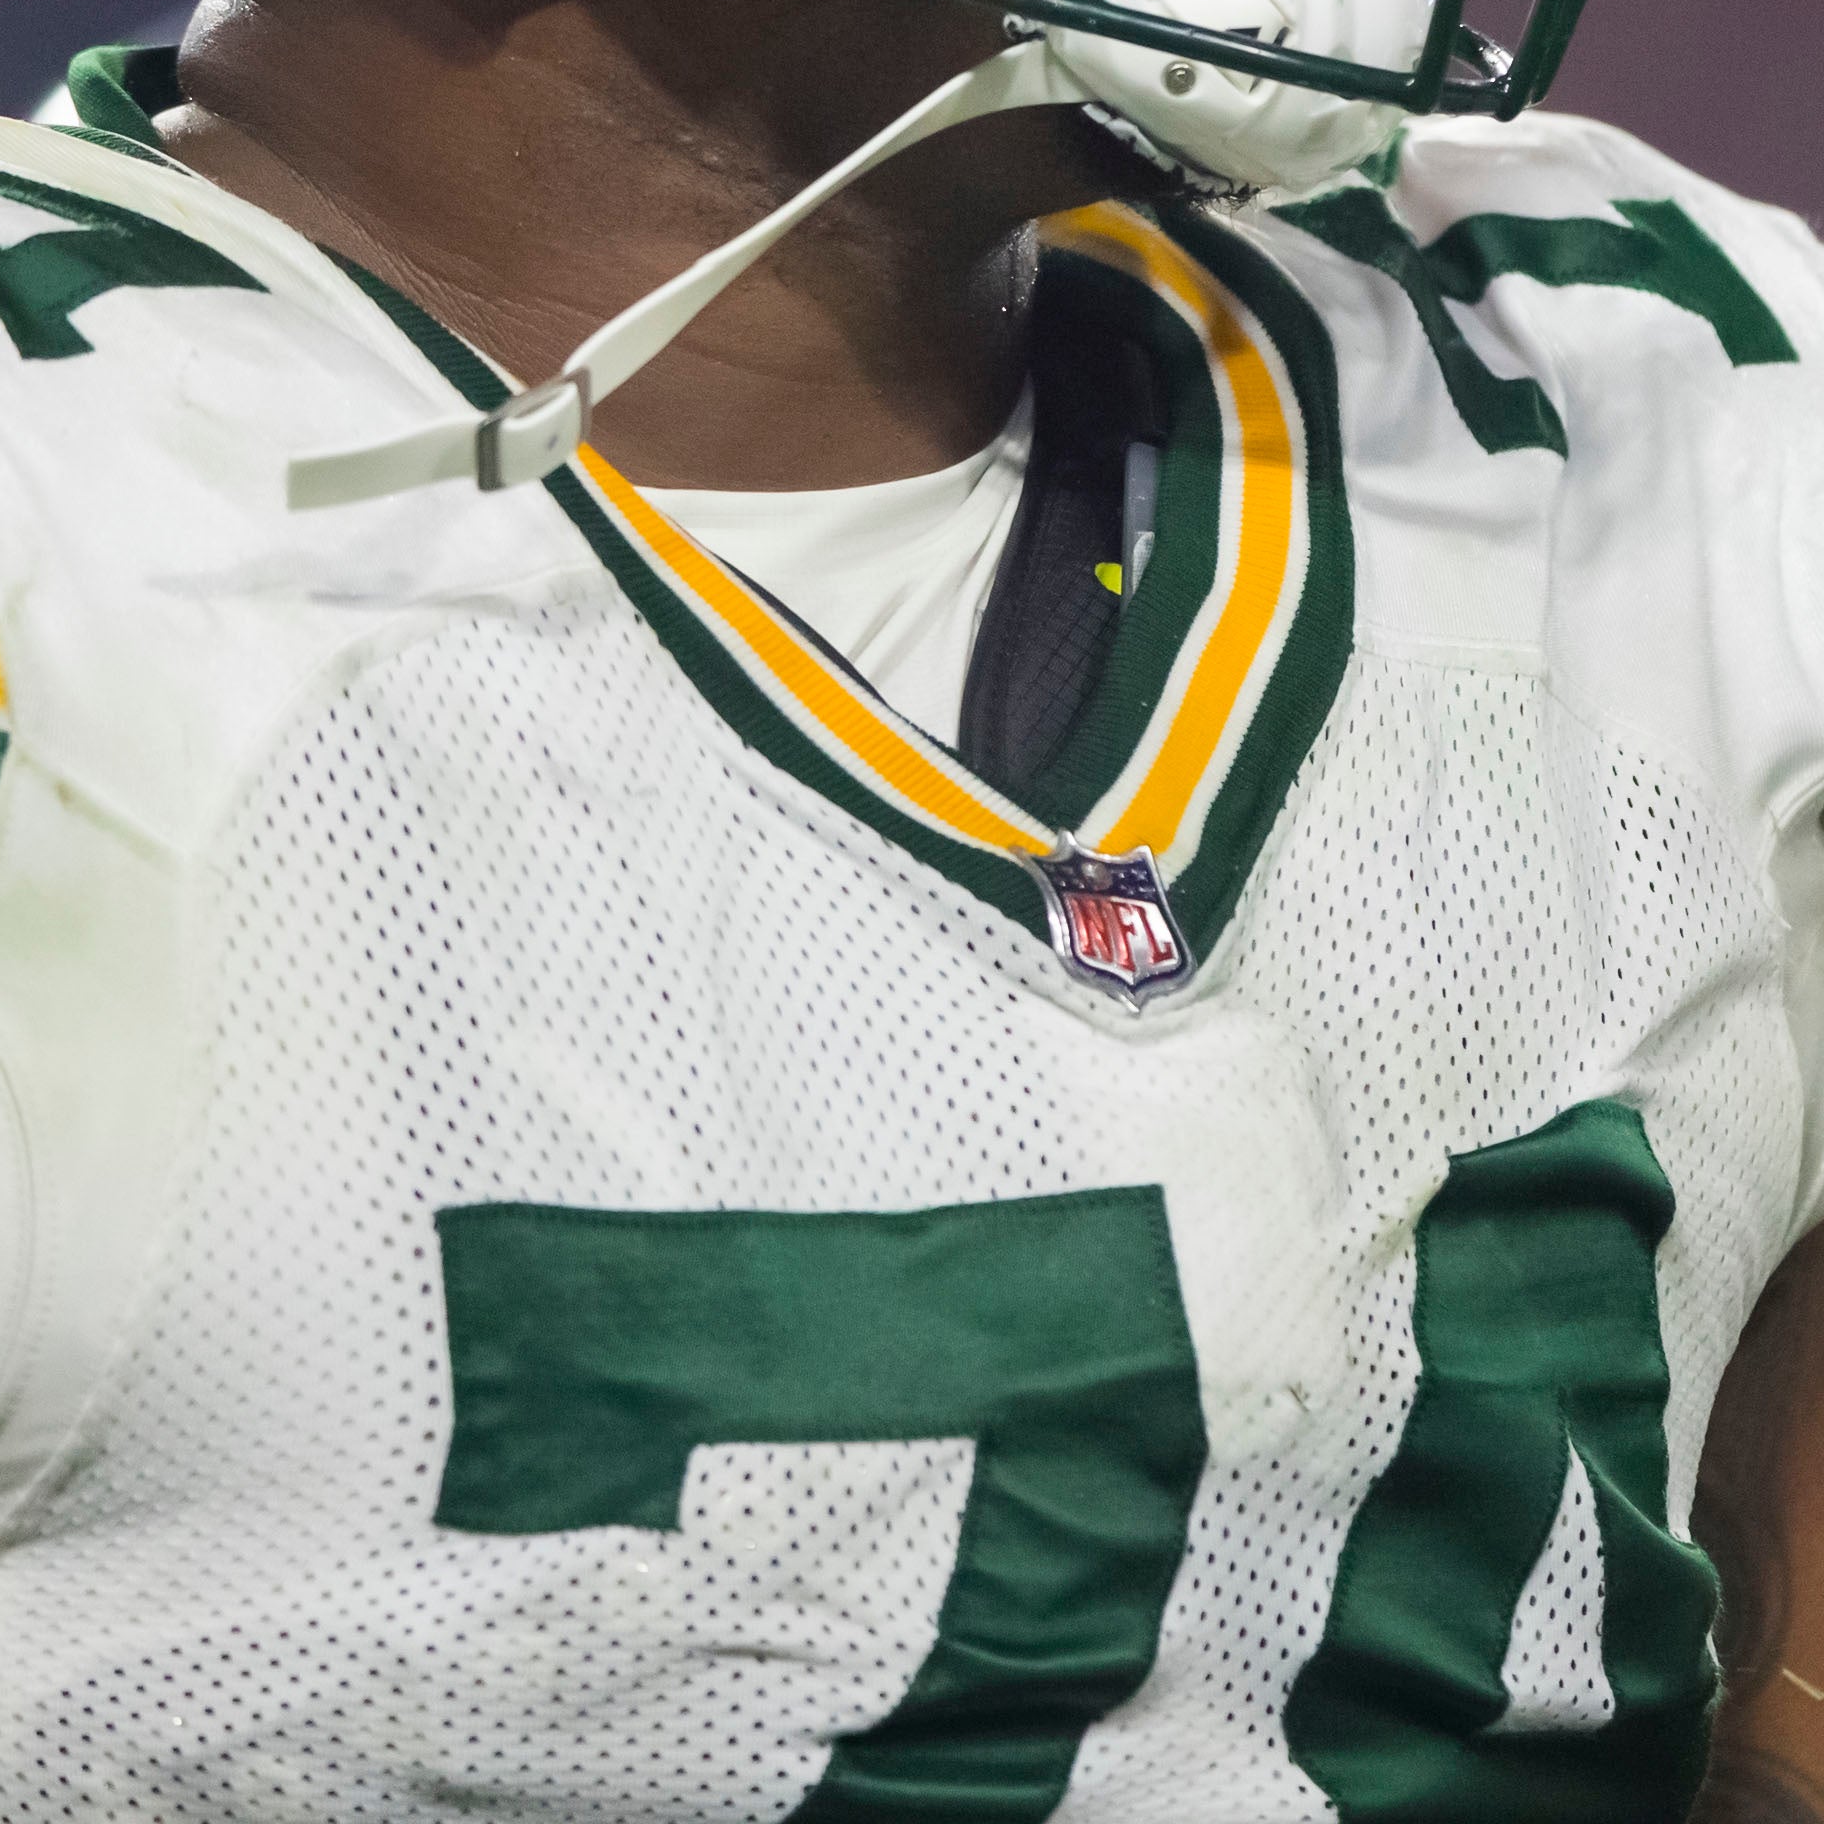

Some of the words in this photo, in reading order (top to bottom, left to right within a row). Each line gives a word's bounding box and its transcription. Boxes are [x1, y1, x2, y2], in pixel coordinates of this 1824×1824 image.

[1266, 184, 1801, 462] 7
[1070, 897, 1175, 973] NFL
[432, 1098, 1726, 1824] 74
